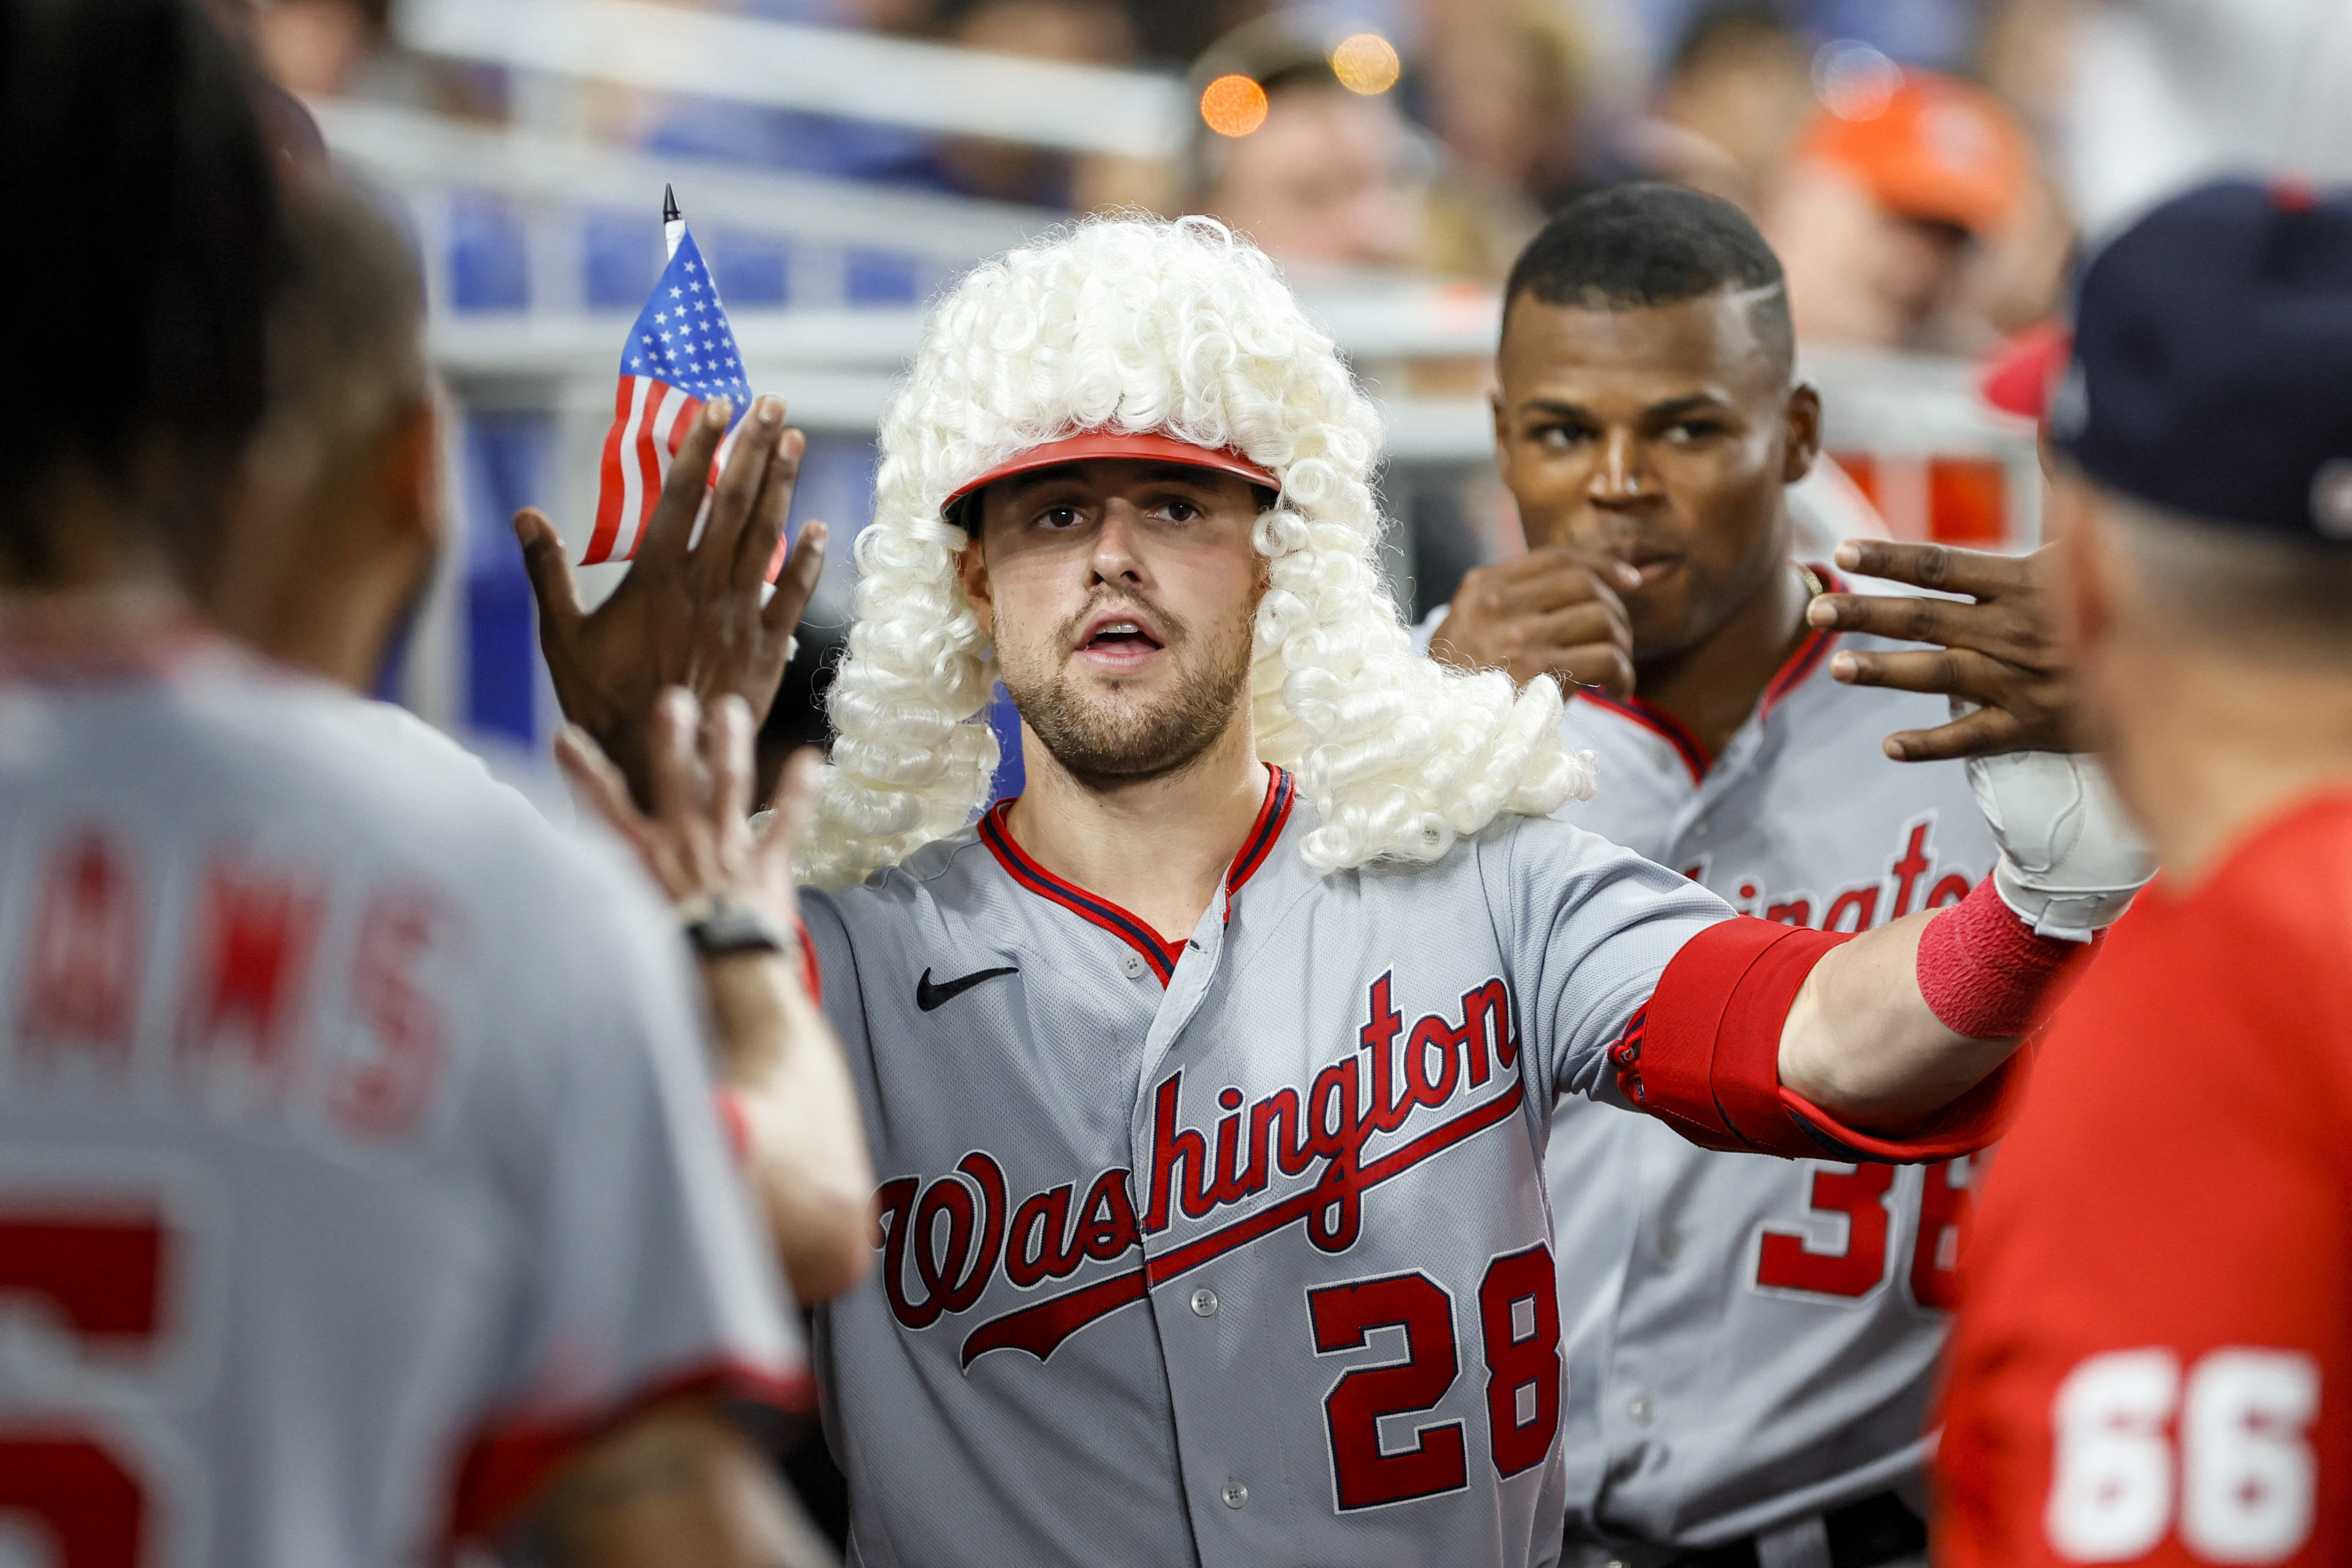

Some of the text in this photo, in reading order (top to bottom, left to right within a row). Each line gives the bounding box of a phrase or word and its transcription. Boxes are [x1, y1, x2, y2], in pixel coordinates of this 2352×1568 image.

[867, 963, 1520, 1332] Washington
[1304, 1238, 1564, 1516] 28
[2043, 1344, 2324, 1567] 66
